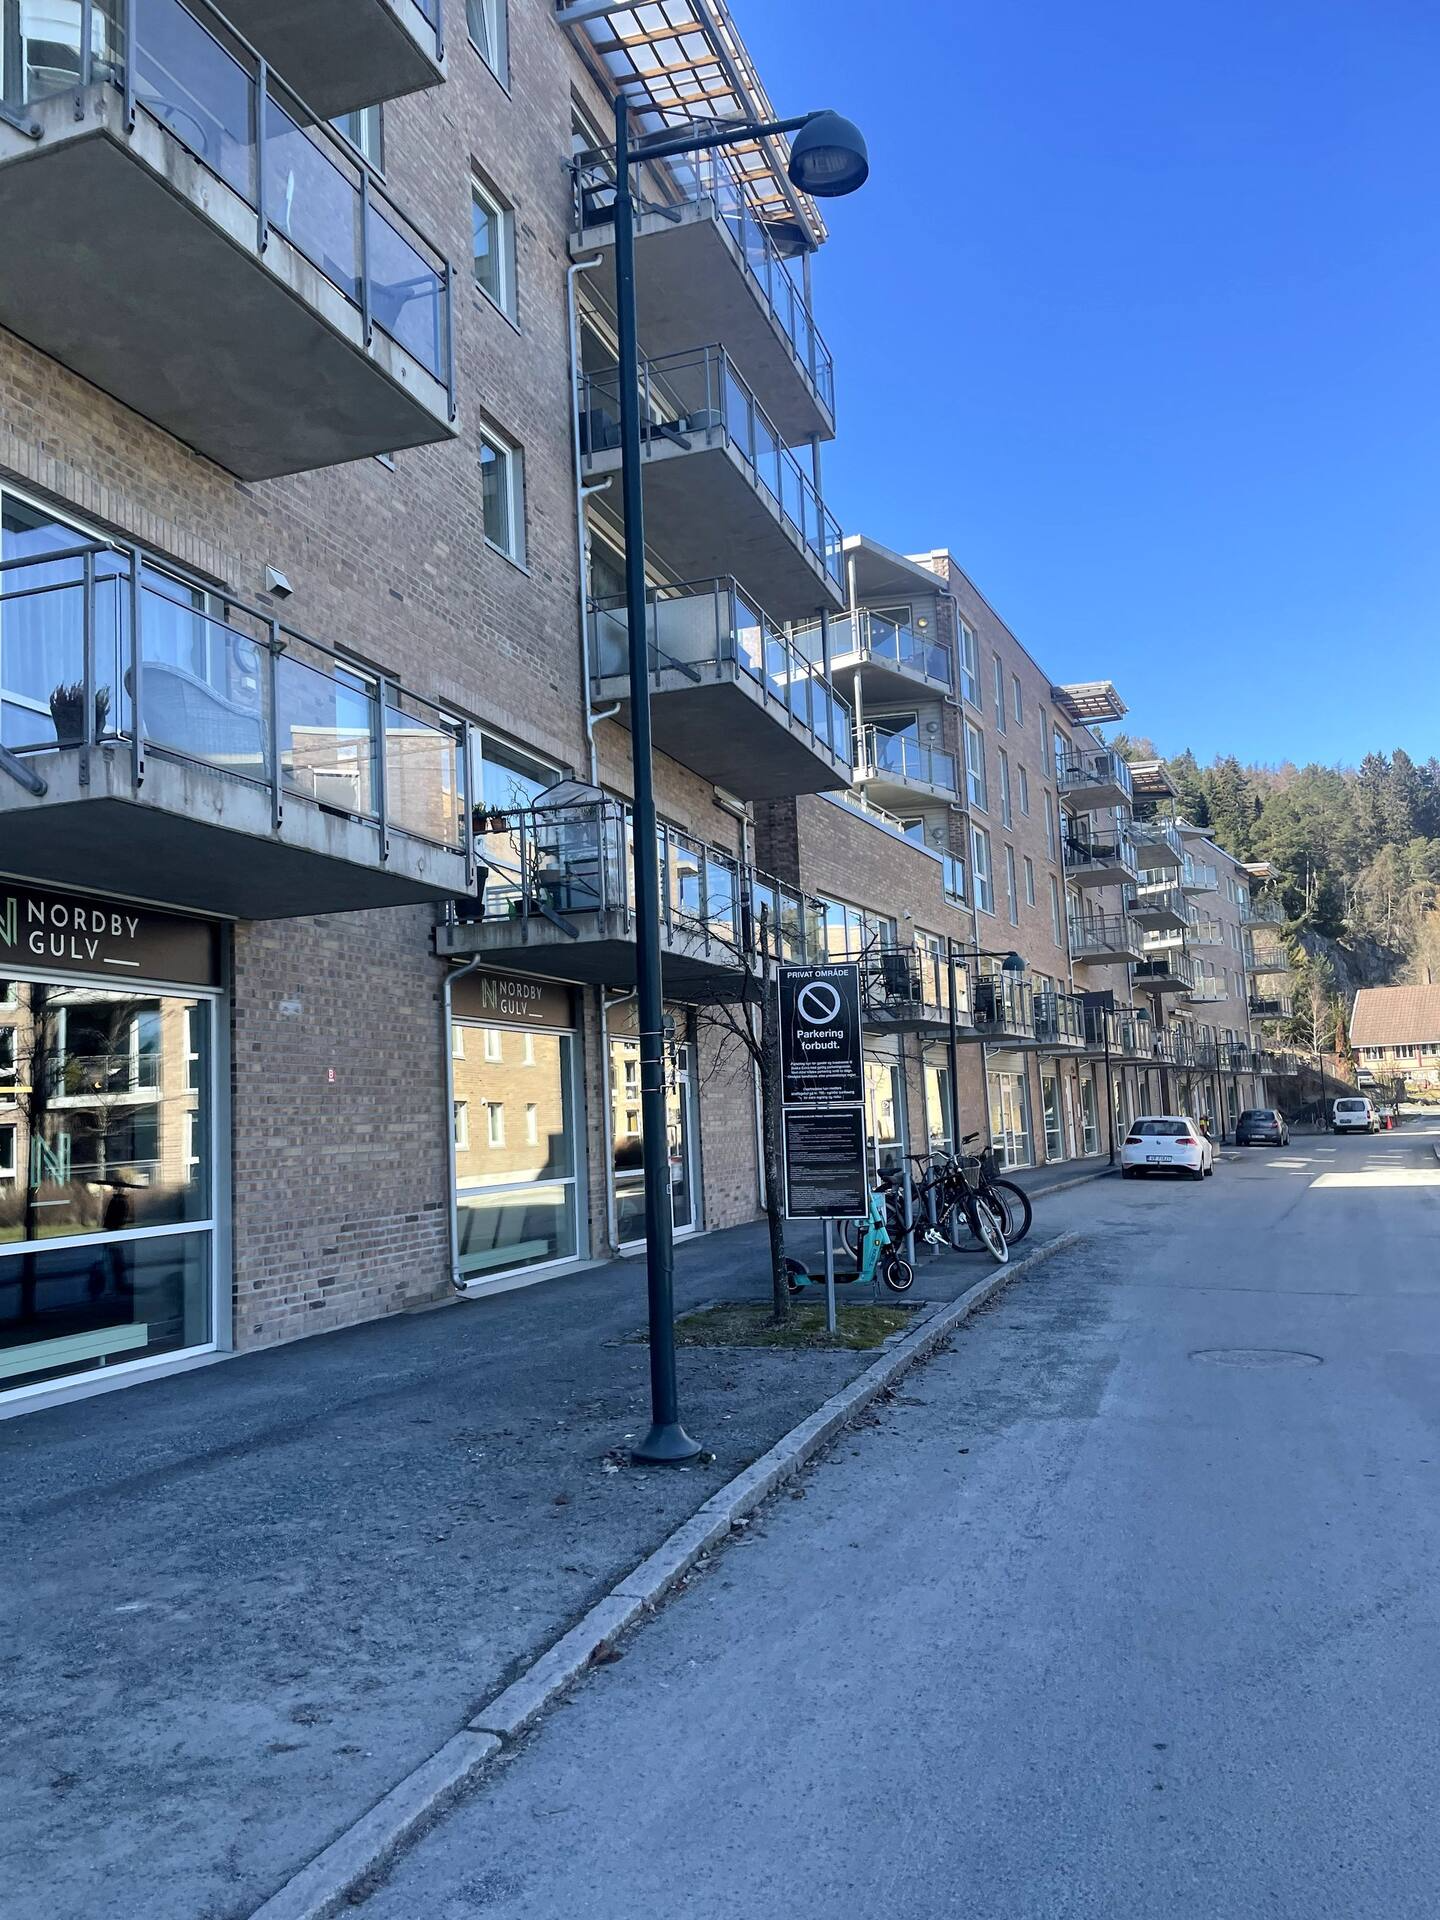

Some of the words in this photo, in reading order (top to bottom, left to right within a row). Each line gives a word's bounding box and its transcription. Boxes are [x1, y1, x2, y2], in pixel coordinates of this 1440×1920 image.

[27, 899, 139, 938] NORDBY
[28, 931, 99, 960] GULV
[787, 970, 813, 979] PRIVAT
[815, 968, 849, 978] OMRÅDE
[499, 981, 543, 1000] NORDBY
[500, 999, 527, 1015] GULV
[796, 1029, 844, 1039] Parkering
[801, 1041, 840, 1050] forbudt.
